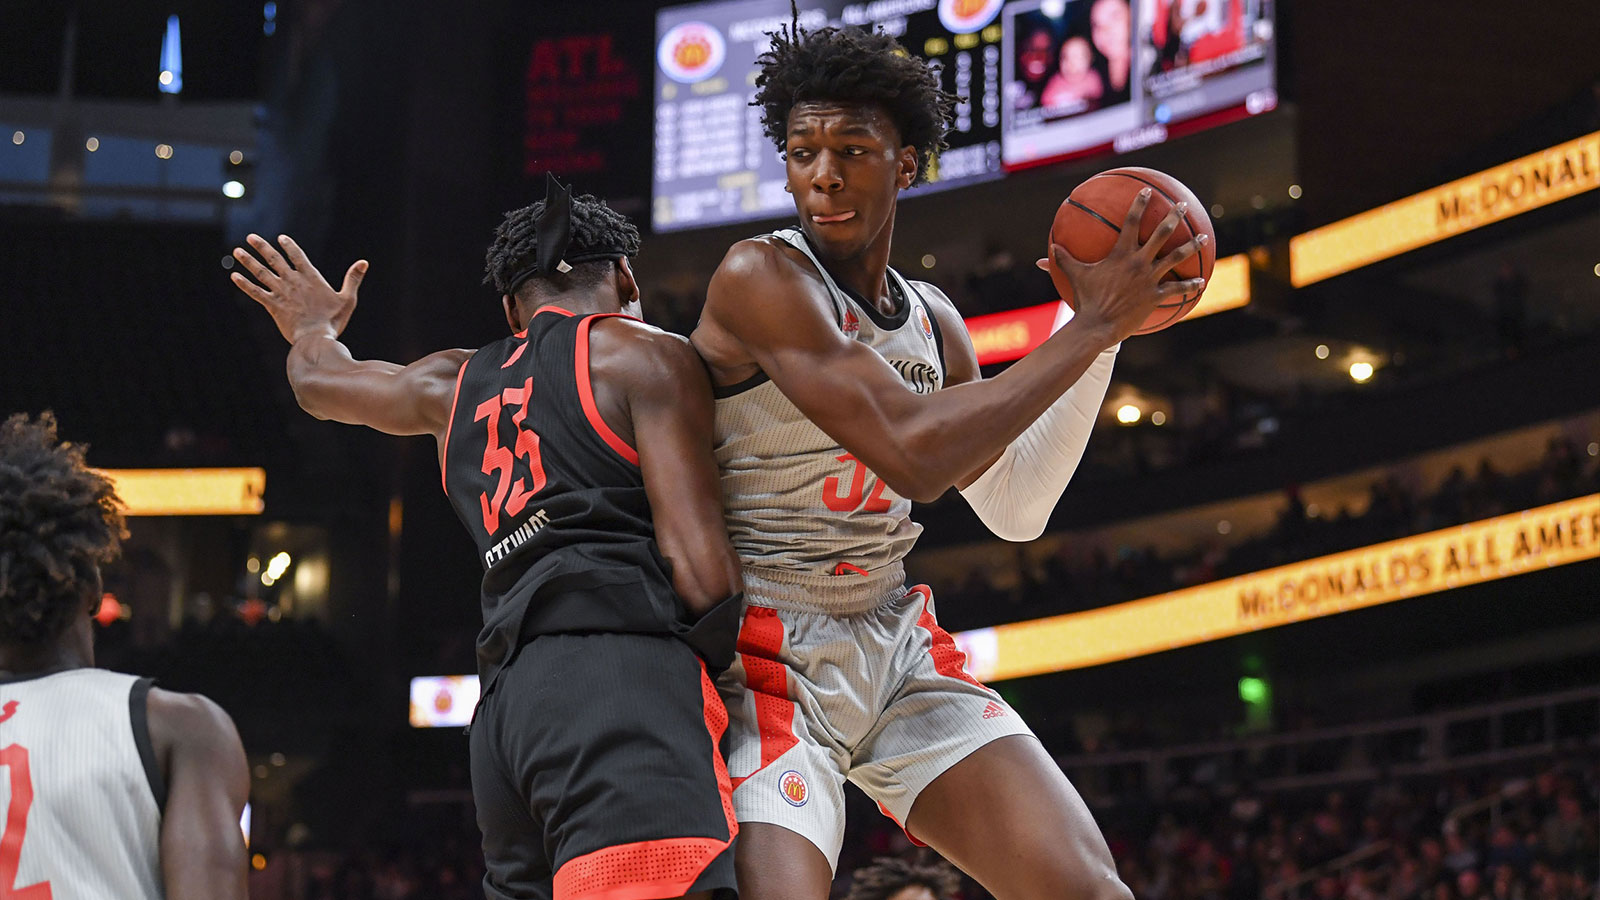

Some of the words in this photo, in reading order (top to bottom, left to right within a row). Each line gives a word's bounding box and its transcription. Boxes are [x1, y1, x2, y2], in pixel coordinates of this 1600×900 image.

[527, 33, 625, 80] ATL
[474, 376, 546, 537] 33
[1443, 534, 1498, 575] ALL
